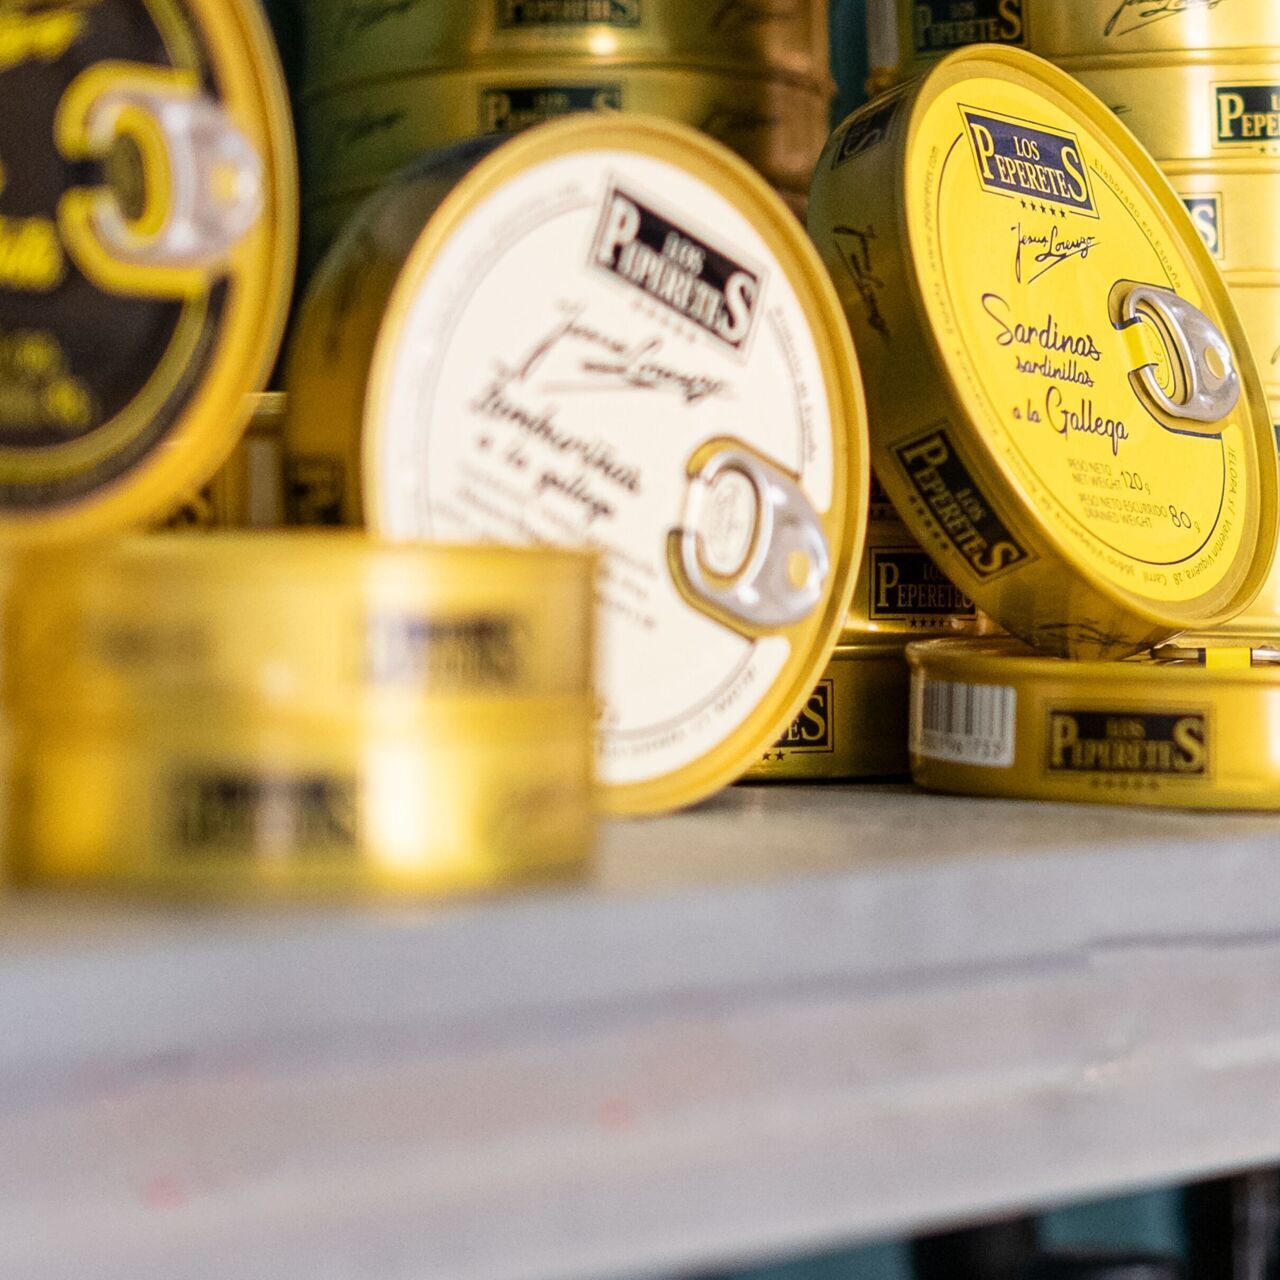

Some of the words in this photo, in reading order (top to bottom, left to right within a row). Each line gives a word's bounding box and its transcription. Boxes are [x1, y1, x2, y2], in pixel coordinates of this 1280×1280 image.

[969, 122, 1088, 203] PEPERETES
[1013, 135, 1041, 161] LOS
[981, 292, 1103, 362] Sardinas
[1015, 354, 1096, 389] sardinillas
[1012, 405, 1024, 420] a
[1026, 398, 1042, 425] la
[1045, 385, 1130, 457] Gallega
[1120, 470, 1144, 492] 120
[1168, 504, 1192, 529] 80
